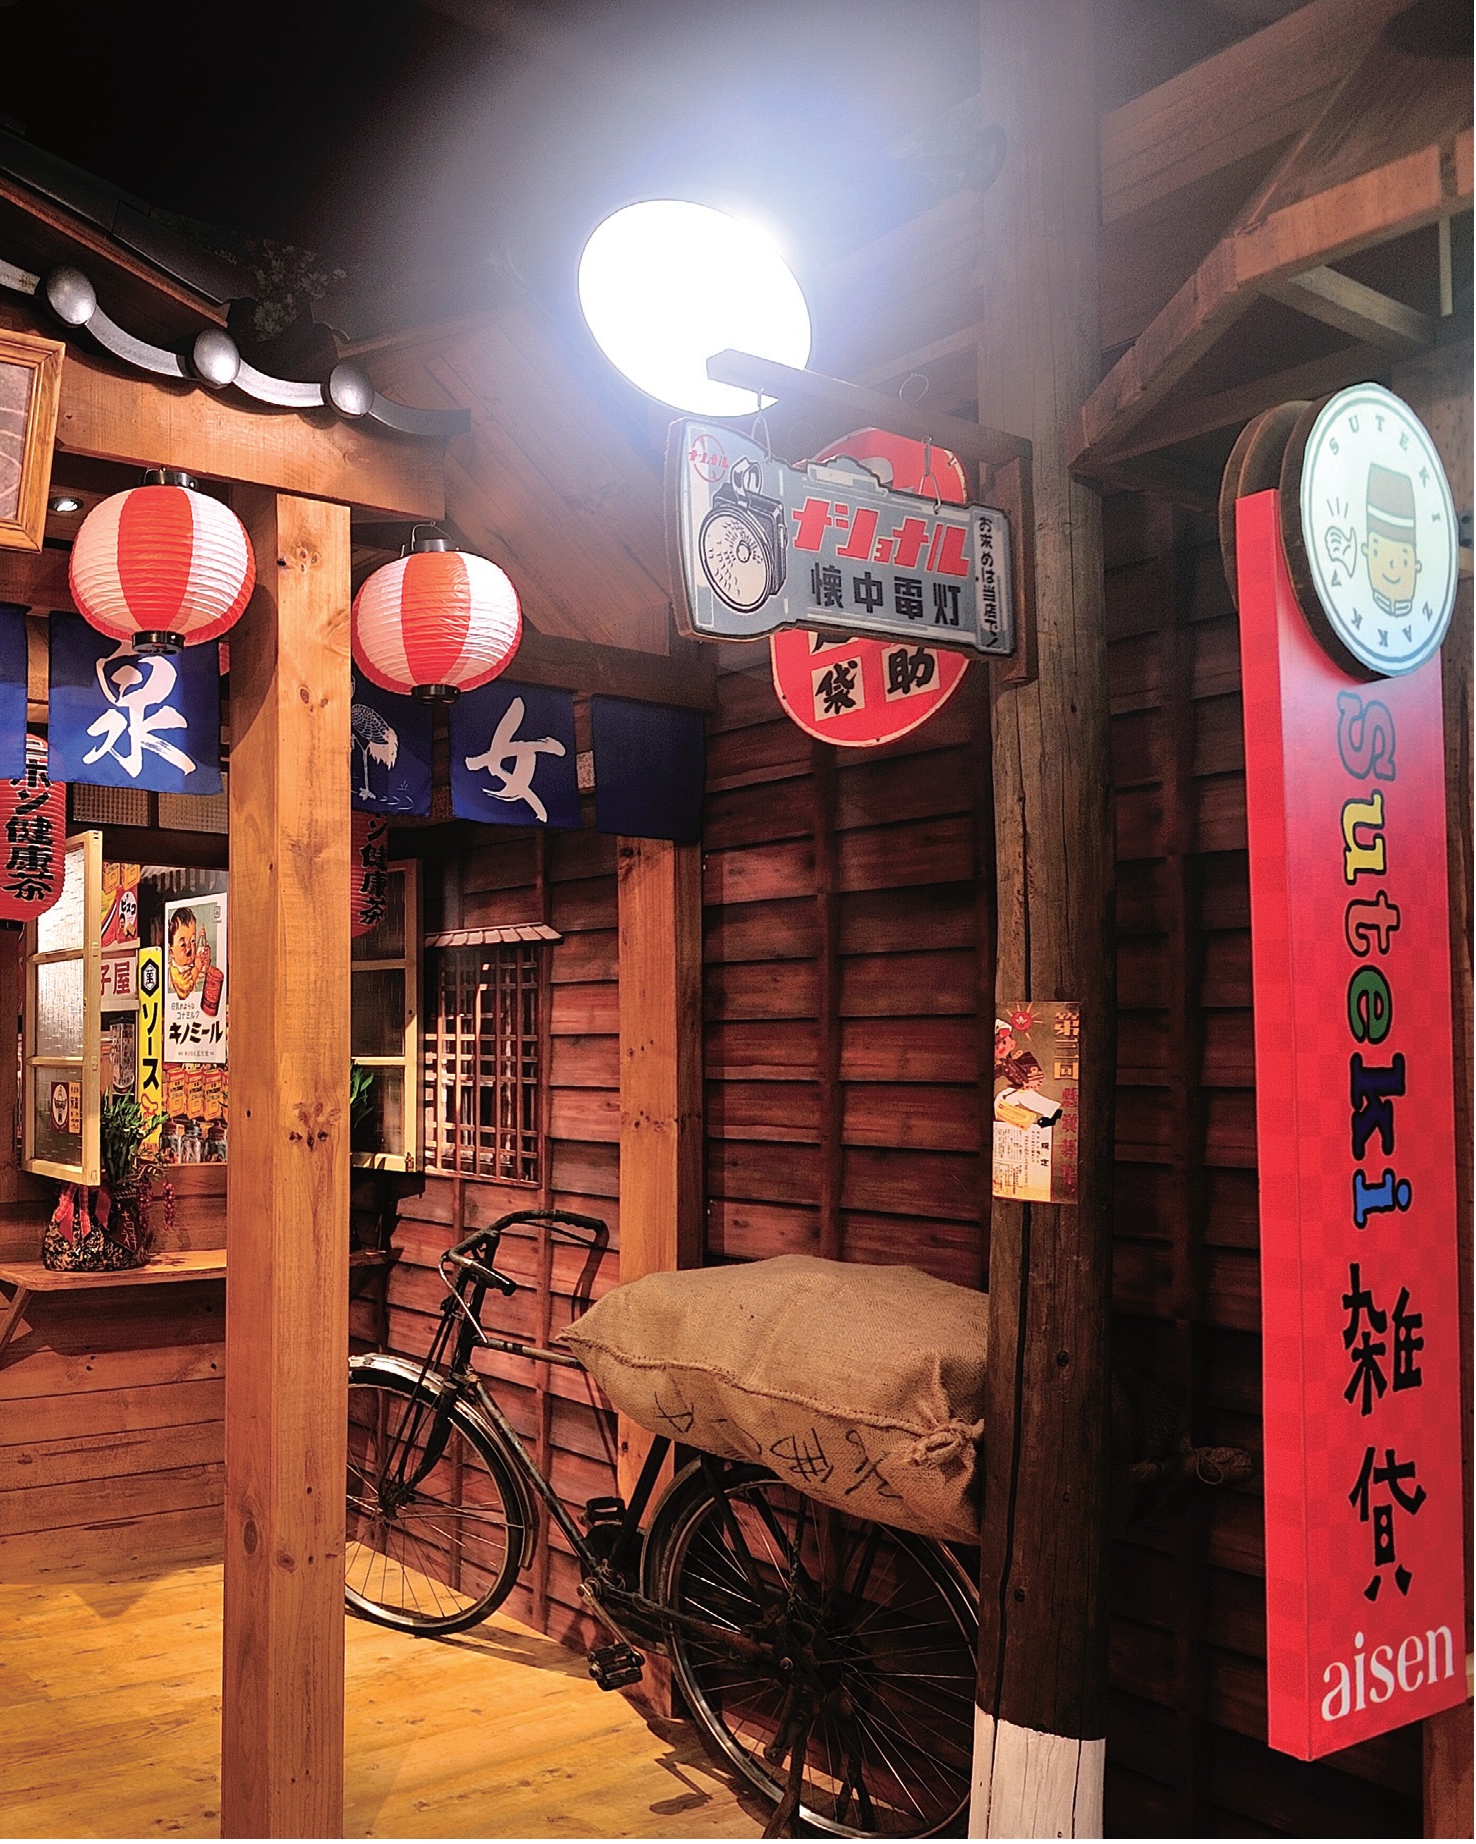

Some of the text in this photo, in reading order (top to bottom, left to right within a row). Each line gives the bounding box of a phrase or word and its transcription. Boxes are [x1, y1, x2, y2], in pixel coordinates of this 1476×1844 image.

[790, 497, 973, 578] ナショナル
[810, 562, 962, 627] 懐中電灯
[80, 648, 201, 780] 泉
[464, 695, 567, 825] 女
[141, 1001, 160, 1091] ソース
[168, 1020, 224, 1045] キノミール
[1341, 1261, 1427, 1603] 雑貨
[1319, 1623, 1455, 1723] aisen
